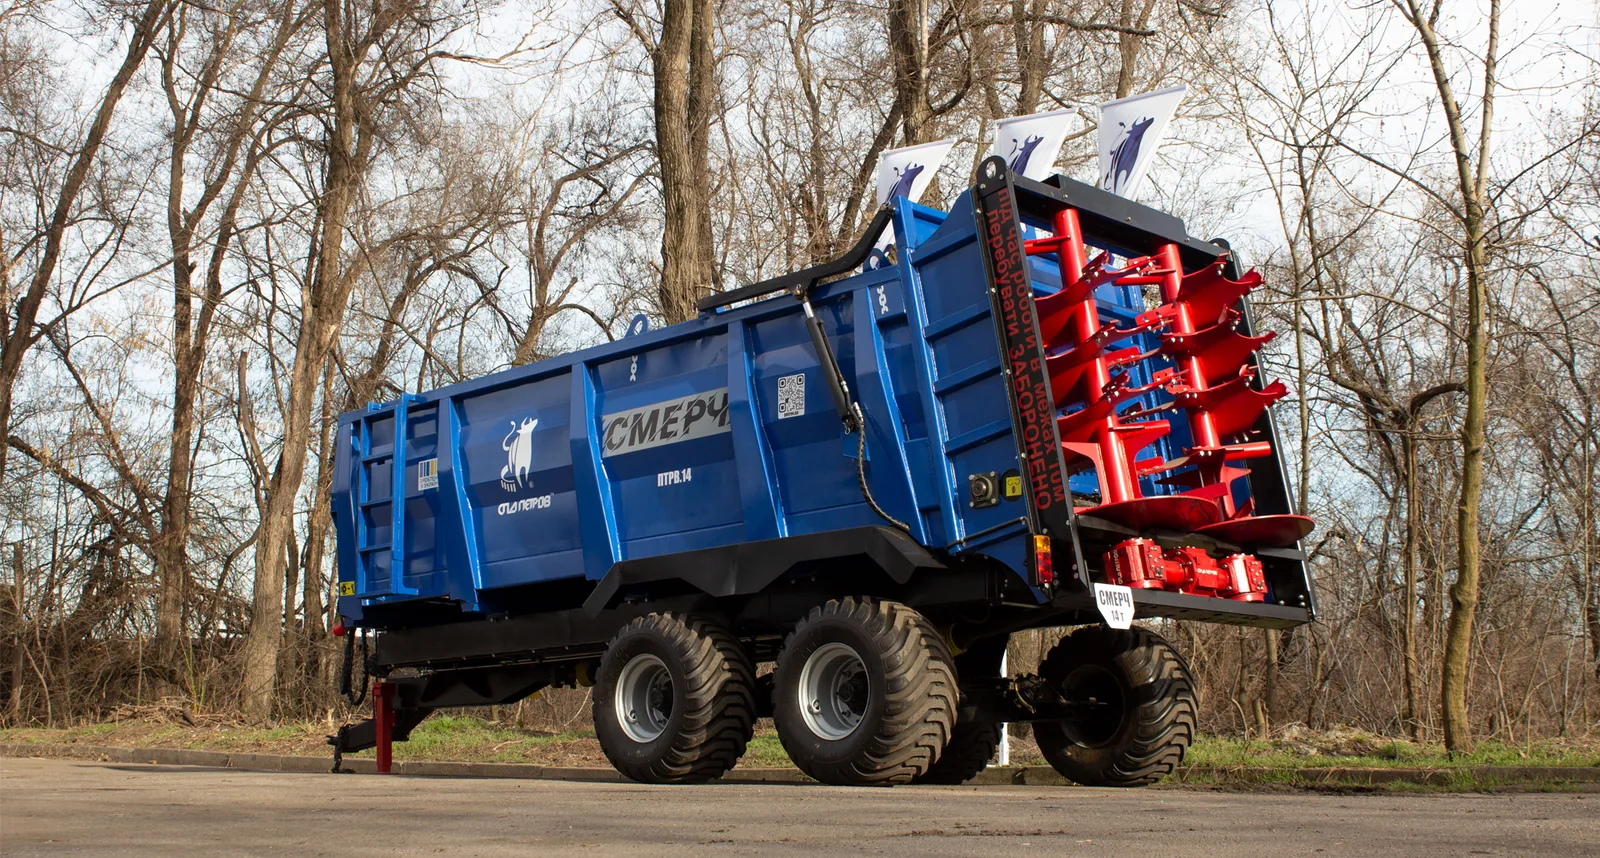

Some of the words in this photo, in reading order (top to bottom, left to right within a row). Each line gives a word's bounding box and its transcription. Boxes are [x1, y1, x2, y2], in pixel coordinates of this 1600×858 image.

[1005, 225, 1021, 265] час
[1034, 380, 1057, 455] межах
[987, 208, 1020, 338] перебувати
[1009, 347, 1051, 511] ЗАБОРОНЕНО
[603, 392, 728, 452] СМЕРЧ
[657, 467, 692, 487] ПТРВ.14
[518, 494, 552, 512] ПЕТРОВ
[1099, 589, 1131, 608] СМЕРЧ
[1111, 609, 1119, 622] 14
